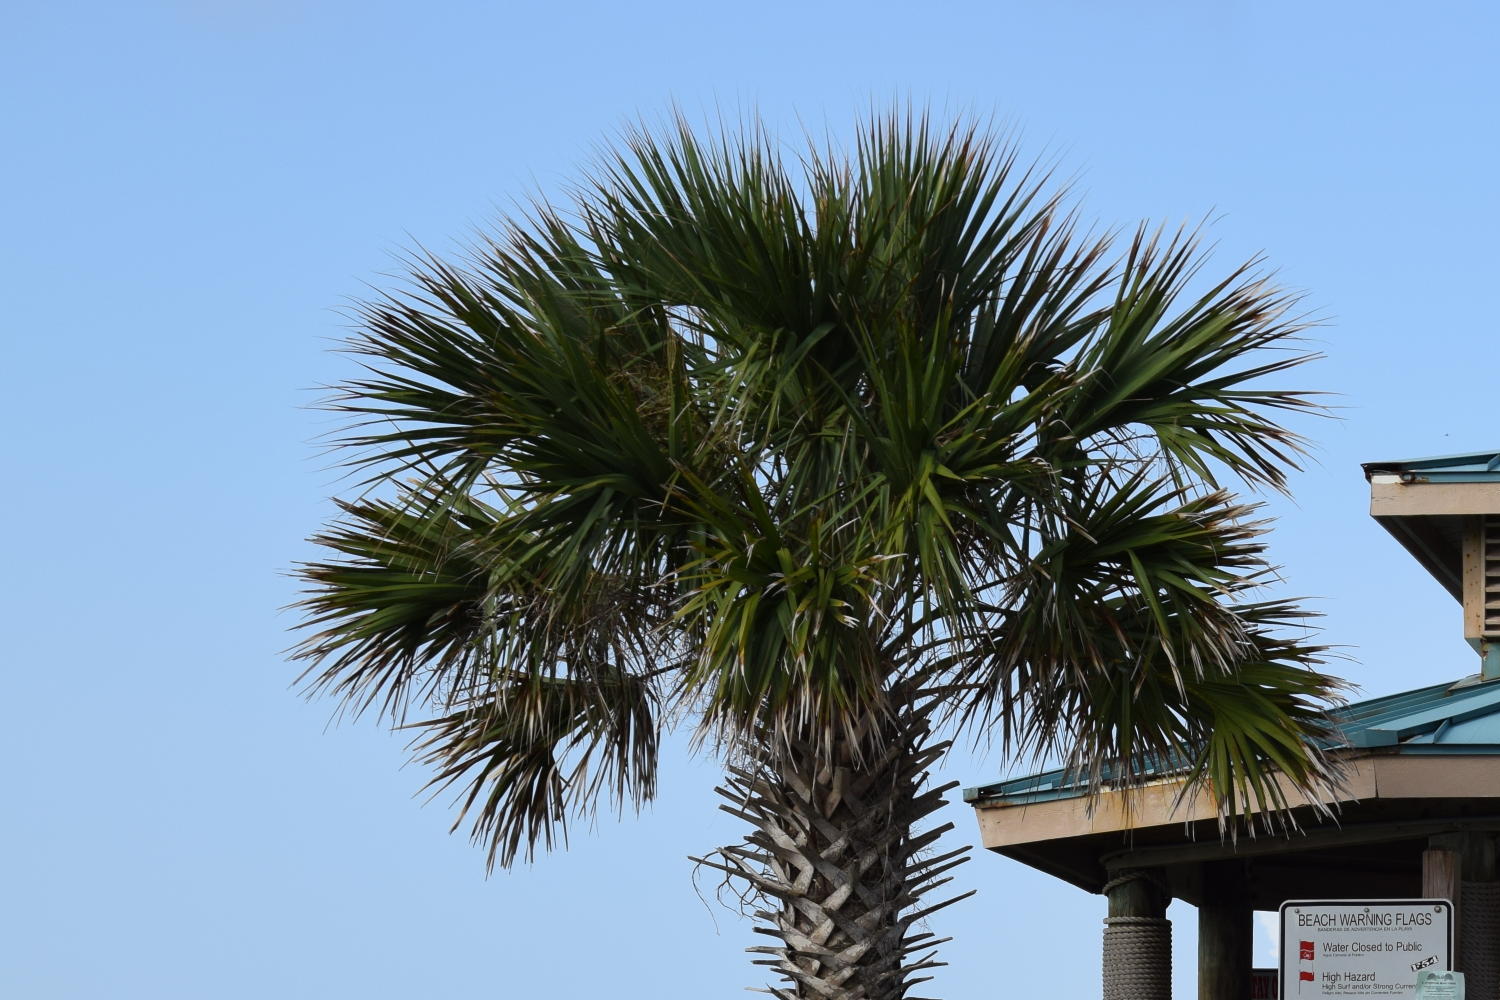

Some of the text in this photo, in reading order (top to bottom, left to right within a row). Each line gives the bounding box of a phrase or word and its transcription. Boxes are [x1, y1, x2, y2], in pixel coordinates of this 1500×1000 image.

[1298, 912, 1432, 927] BEACH WARNING FLAGS
[1323, 941, 1423, 952] Water Closed to Public
[1322, 972, 1376, 984] High Hazard
